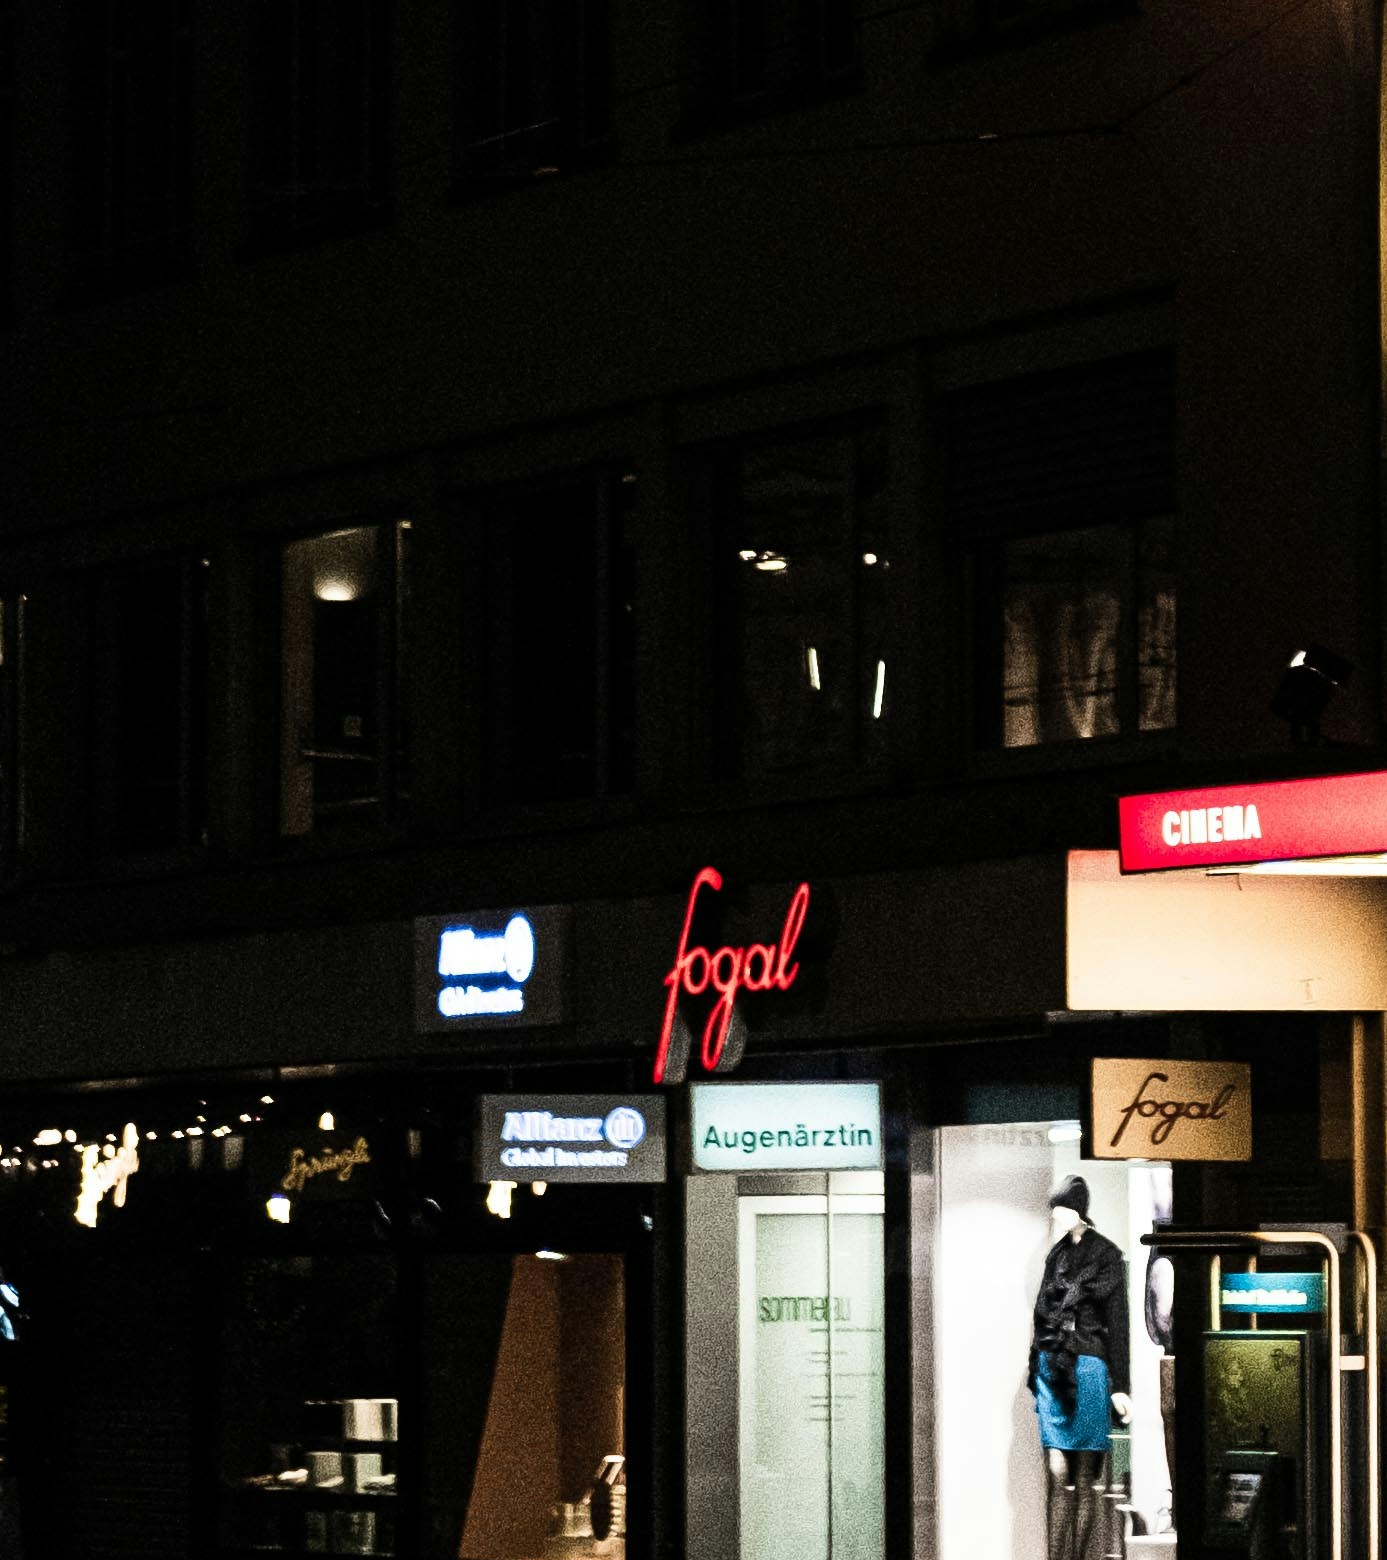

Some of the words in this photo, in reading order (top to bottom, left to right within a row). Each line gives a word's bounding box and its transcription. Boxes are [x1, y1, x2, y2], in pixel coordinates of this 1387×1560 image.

[1161, 804, 1262, 846] CINEMA
[653, 865, 810, 1085] fogal
[501, 1111, 603, 1142] Allianz
[1110, 1072, 1237, 1147] fogal
[703, 1120, 873, 1155] Augenärztin
